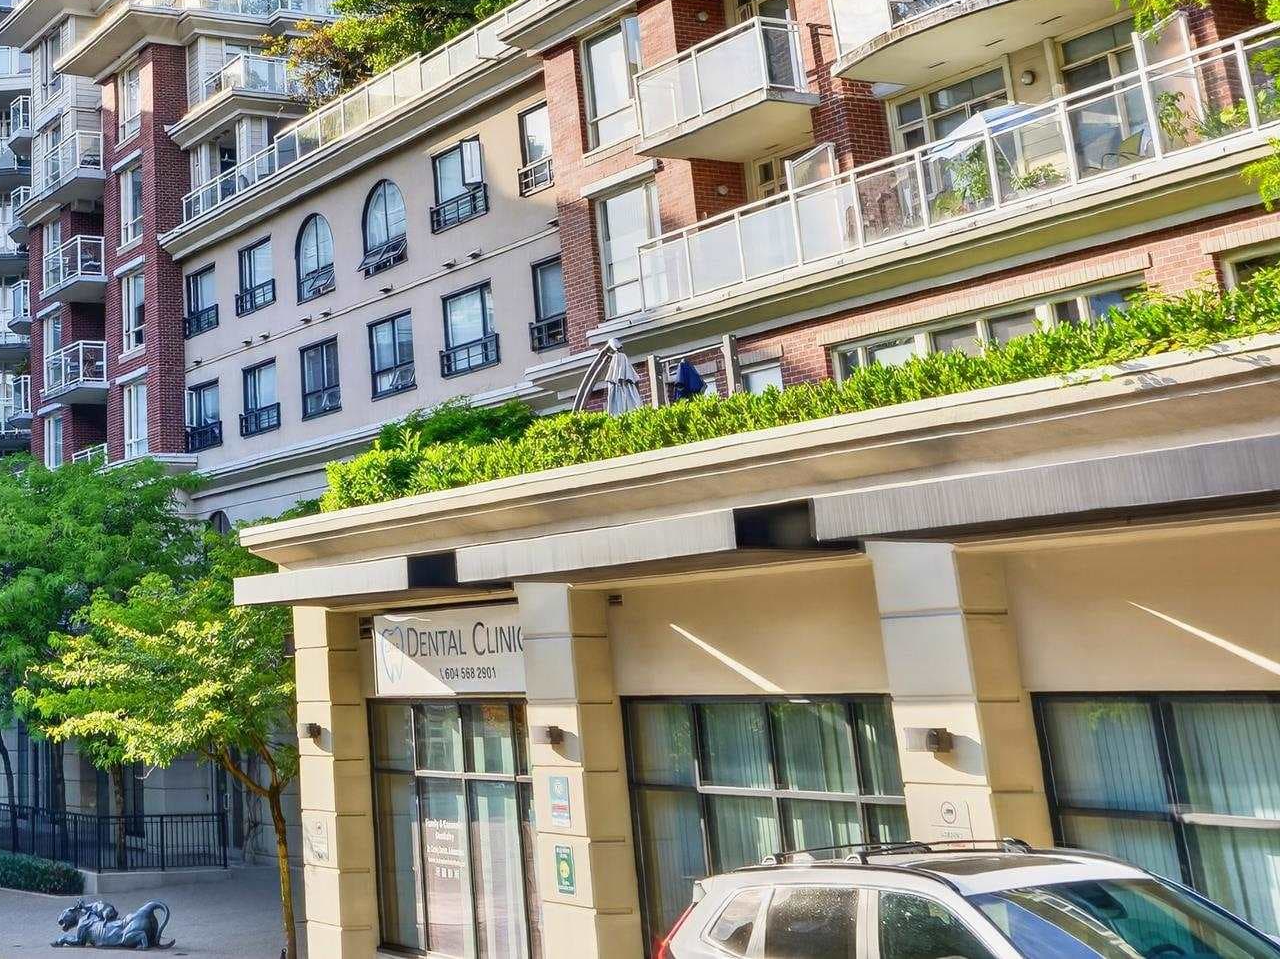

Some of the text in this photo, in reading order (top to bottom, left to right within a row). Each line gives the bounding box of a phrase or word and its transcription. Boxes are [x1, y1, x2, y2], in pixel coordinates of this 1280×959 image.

[406, 626, 467, 657] DENTAL
[445, 667, 459, 680] 604
[476, 666, 497, 679] 2901
